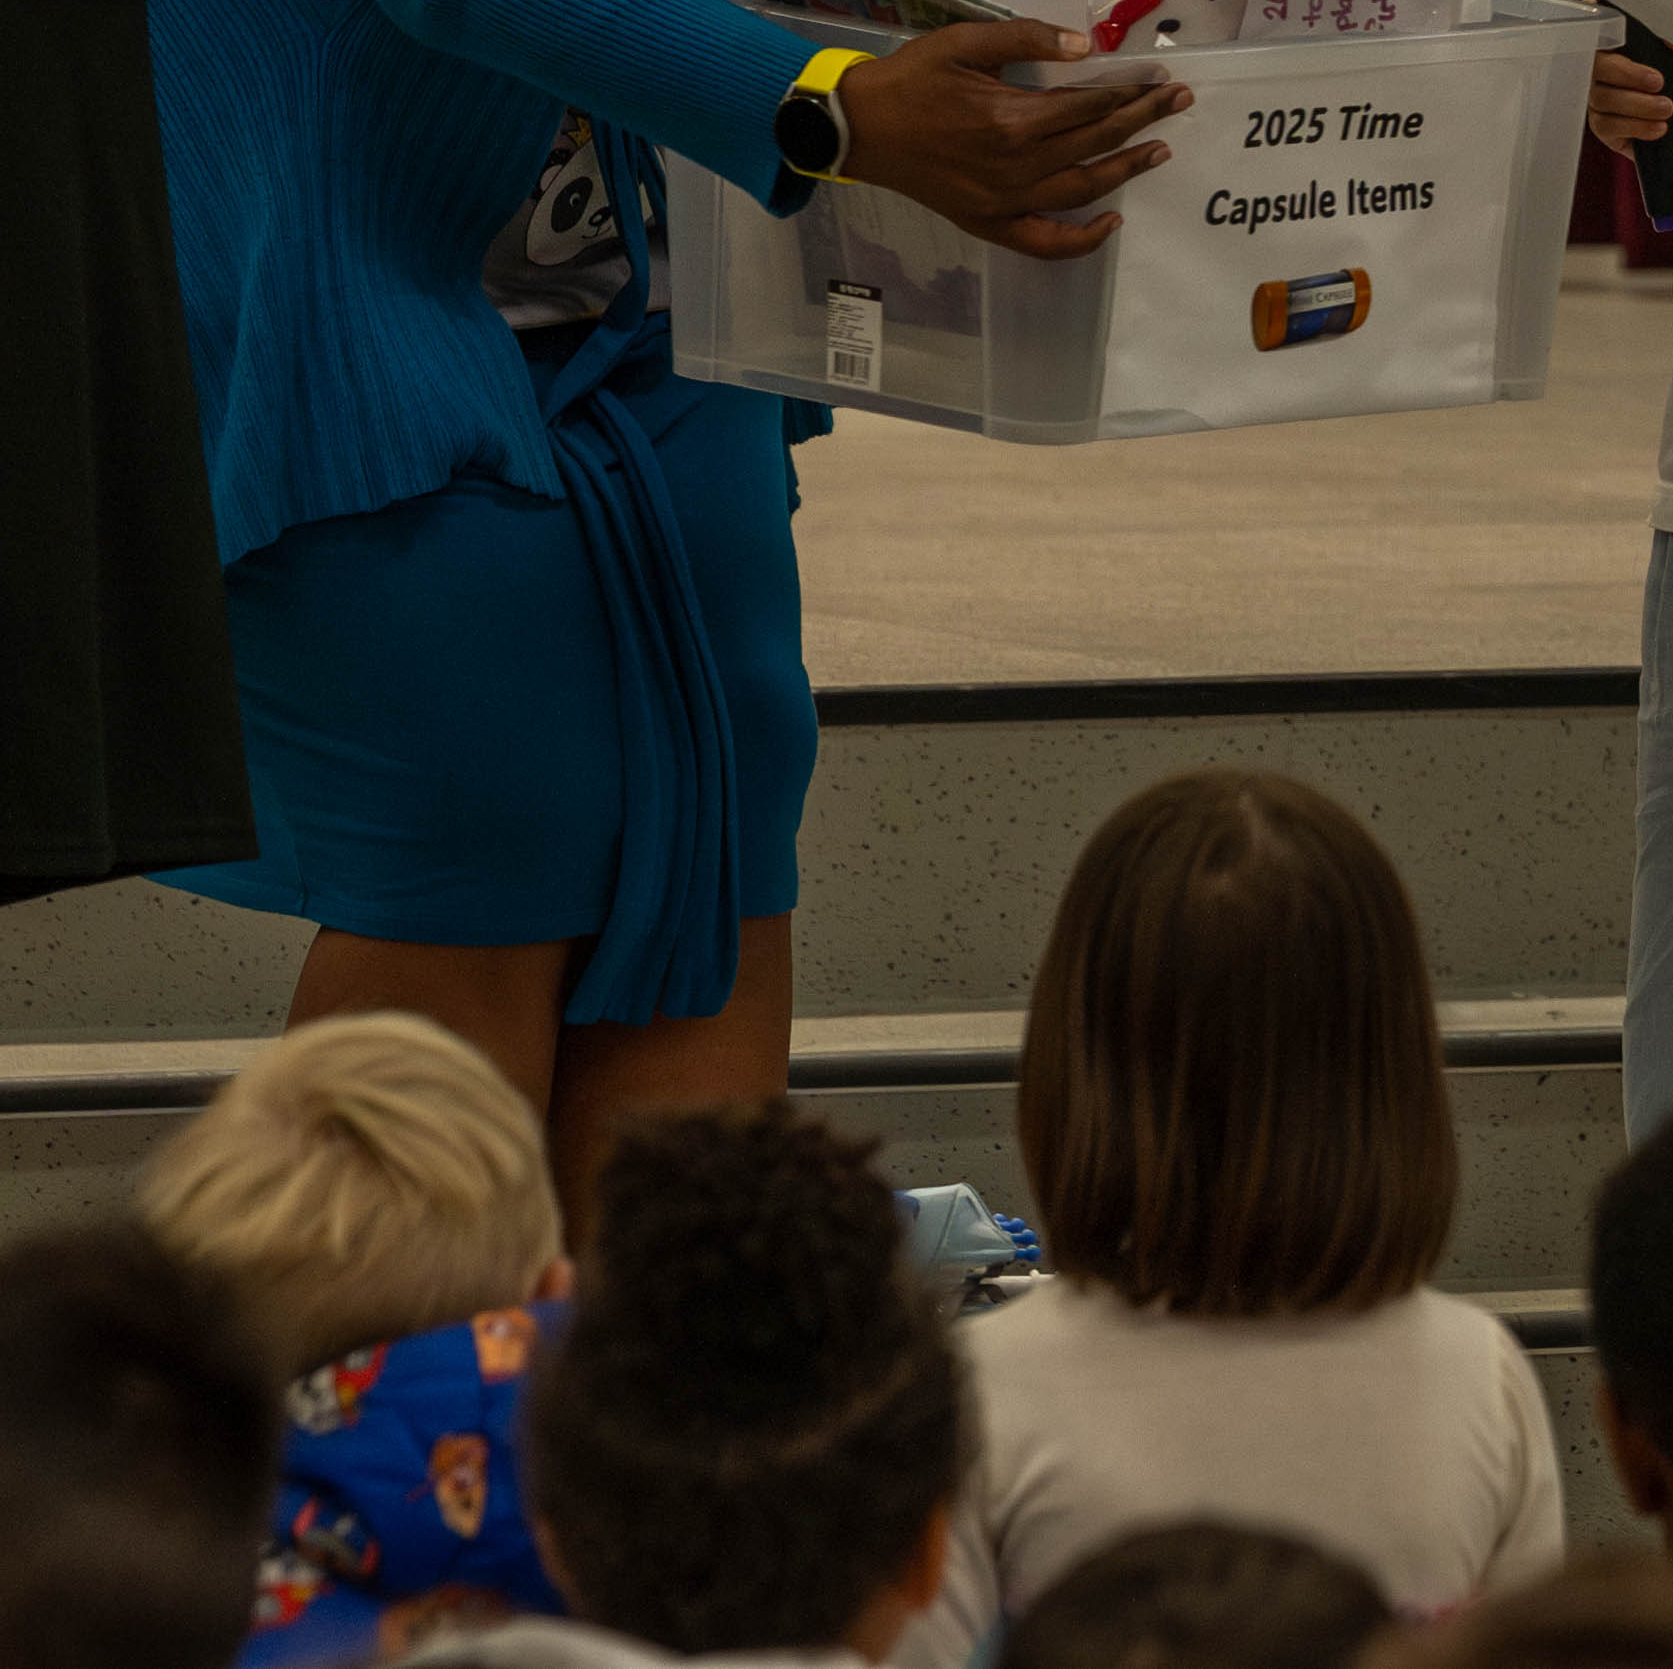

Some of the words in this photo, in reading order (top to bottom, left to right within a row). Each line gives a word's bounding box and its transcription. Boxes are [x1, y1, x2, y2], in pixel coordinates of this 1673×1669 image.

[1243, 106, 1328, 149] 2025
[1340, 102, 1425, 141] Time
[1205, 179, 1336, 235] Capsule
[1347, 178, 1435, 217] Items
